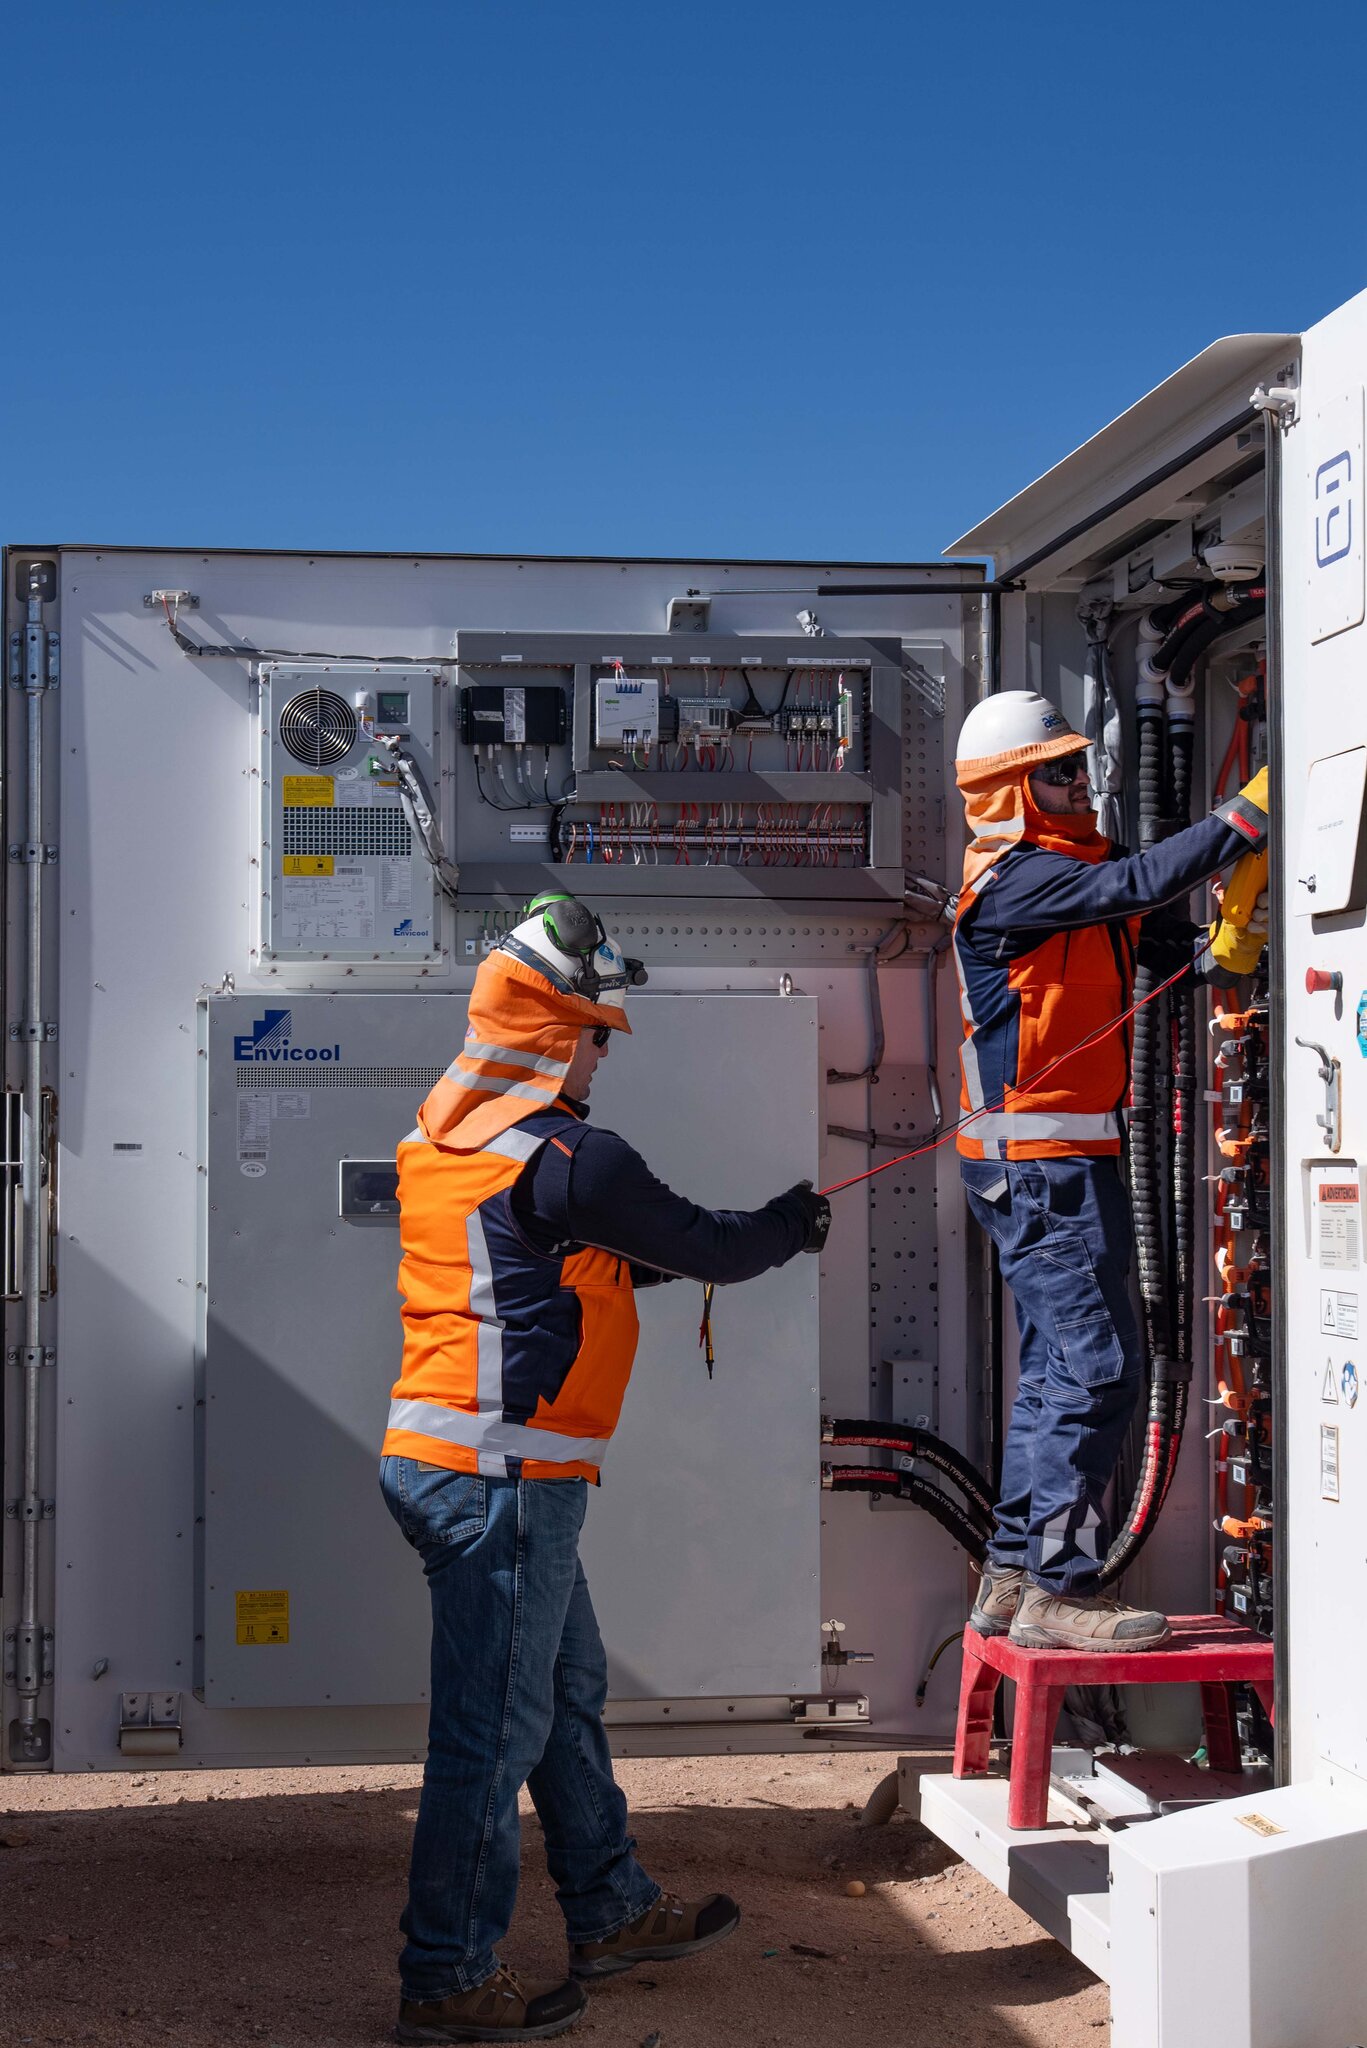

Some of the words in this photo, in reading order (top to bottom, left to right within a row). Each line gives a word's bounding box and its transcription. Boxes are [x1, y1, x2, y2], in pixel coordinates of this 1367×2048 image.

[394, 927, 429, 936] Envicool
[234, 1036, 340, 1061] Envicool
[1327, 1187, 1356, 1200] ADVERTENCIA
[935, 1456, 950, 1469] WALL
[950, 1466, 965, 1481] TYPE
[924, 1485, 940, 1499] WALL
[941, 1496, 955, 1512] TYPE
